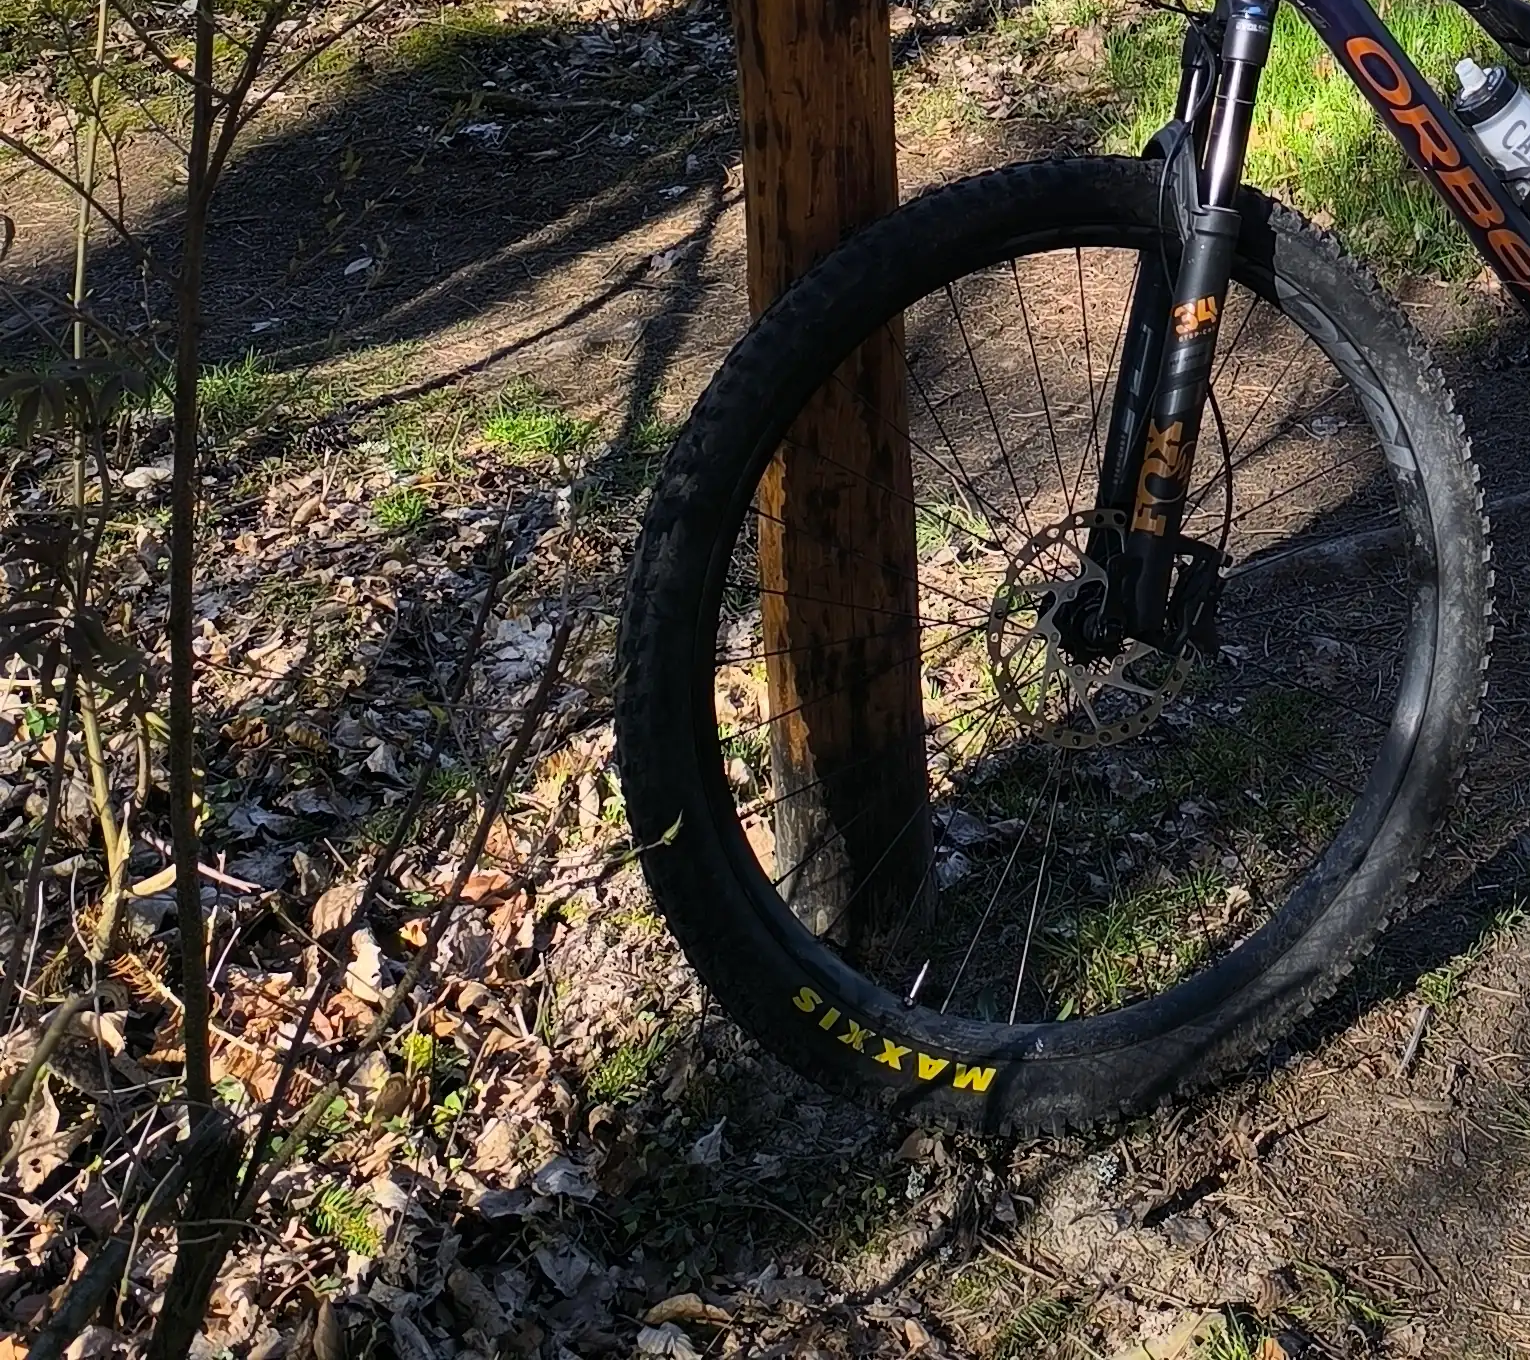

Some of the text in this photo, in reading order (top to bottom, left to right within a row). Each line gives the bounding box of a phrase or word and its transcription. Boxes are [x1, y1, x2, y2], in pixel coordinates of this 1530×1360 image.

[1174, 296, 1218, 334] 34
[1130, 418, 1194, 537] FOX
[792, 986, 997, 1092] MAXXIS
